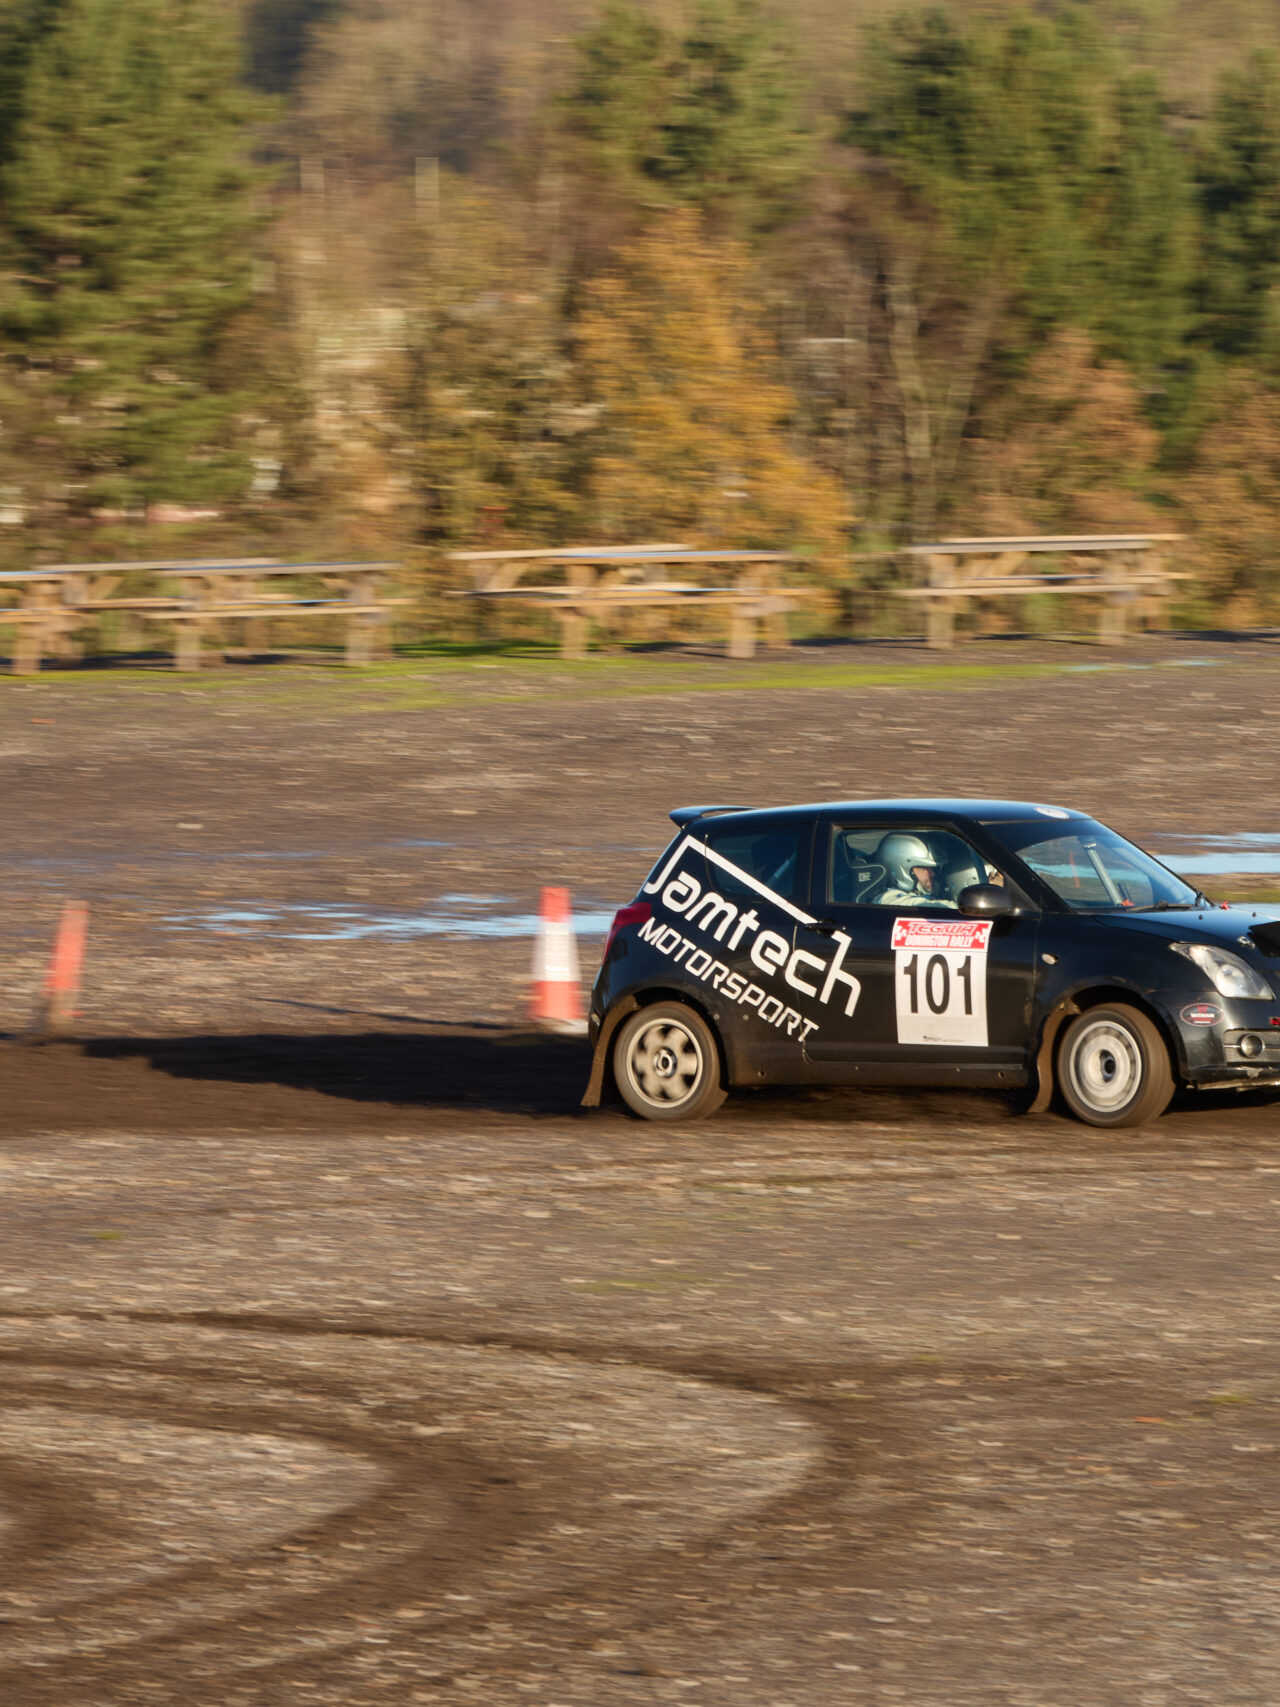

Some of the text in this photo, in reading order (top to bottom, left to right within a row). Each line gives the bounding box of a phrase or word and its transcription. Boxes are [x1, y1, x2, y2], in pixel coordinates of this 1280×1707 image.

[949, 936, 974, 948] RALLY
[638, 916, 820, 1042] MOTORSPORT
[903, 953, 973, 1016] 101
